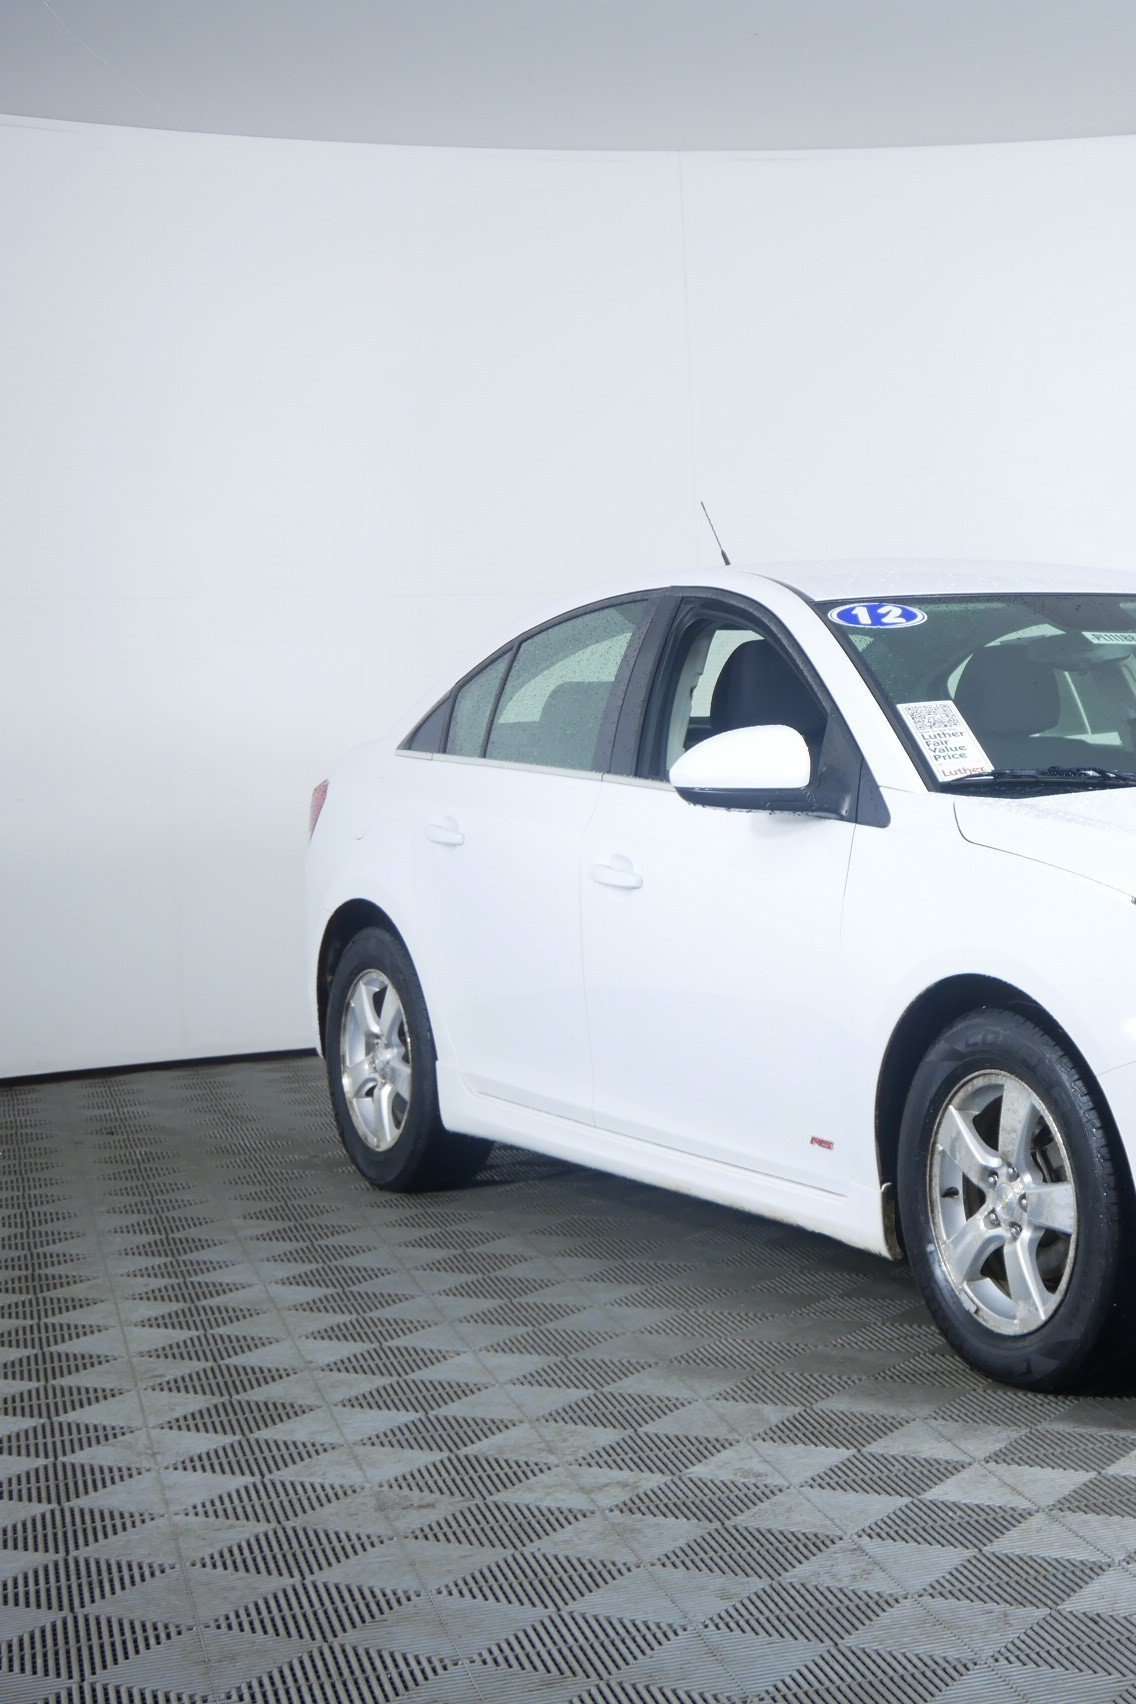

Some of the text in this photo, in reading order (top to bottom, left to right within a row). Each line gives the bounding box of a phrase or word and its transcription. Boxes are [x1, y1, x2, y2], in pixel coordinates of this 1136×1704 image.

[851, 605, 907, 625] 12
[921, 731, 965, 741] Luther
[925, 740, 949, 748] Fair
[928, 745, 967, 754] Value
[933, 752, 968, 761] Price
[941, 766, 985, 777] Luther
